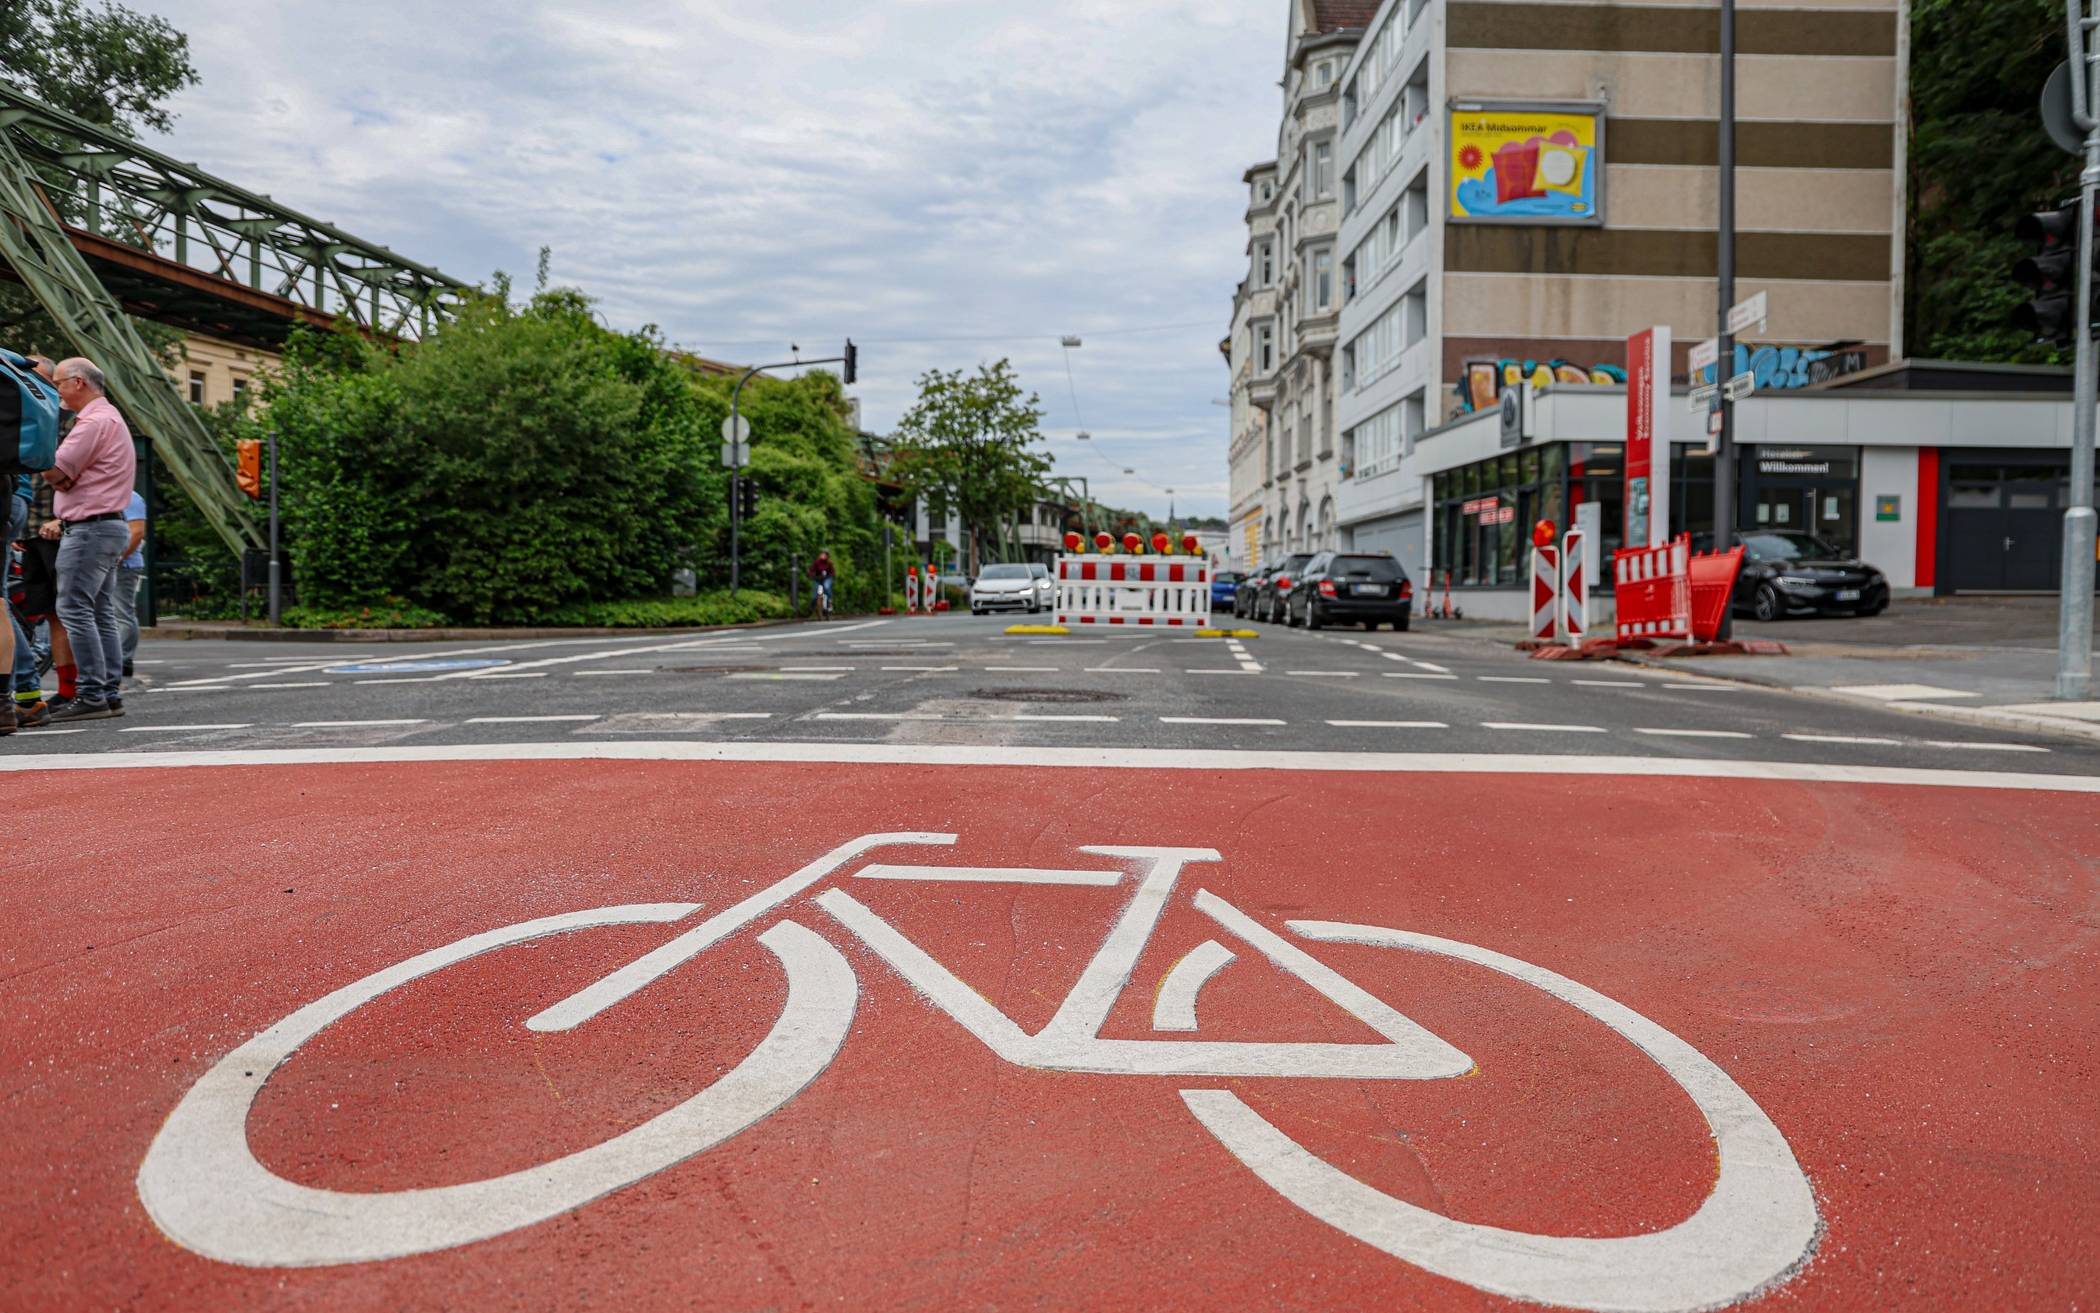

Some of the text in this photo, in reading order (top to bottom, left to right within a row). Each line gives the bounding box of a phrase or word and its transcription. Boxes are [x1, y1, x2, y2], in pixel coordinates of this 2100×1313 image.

[1461, 123, 1484, 131] IKEA
[1487, 123, 1547, 132] Midsommar
[1759, 460, 1830, 473] Willkommen!
